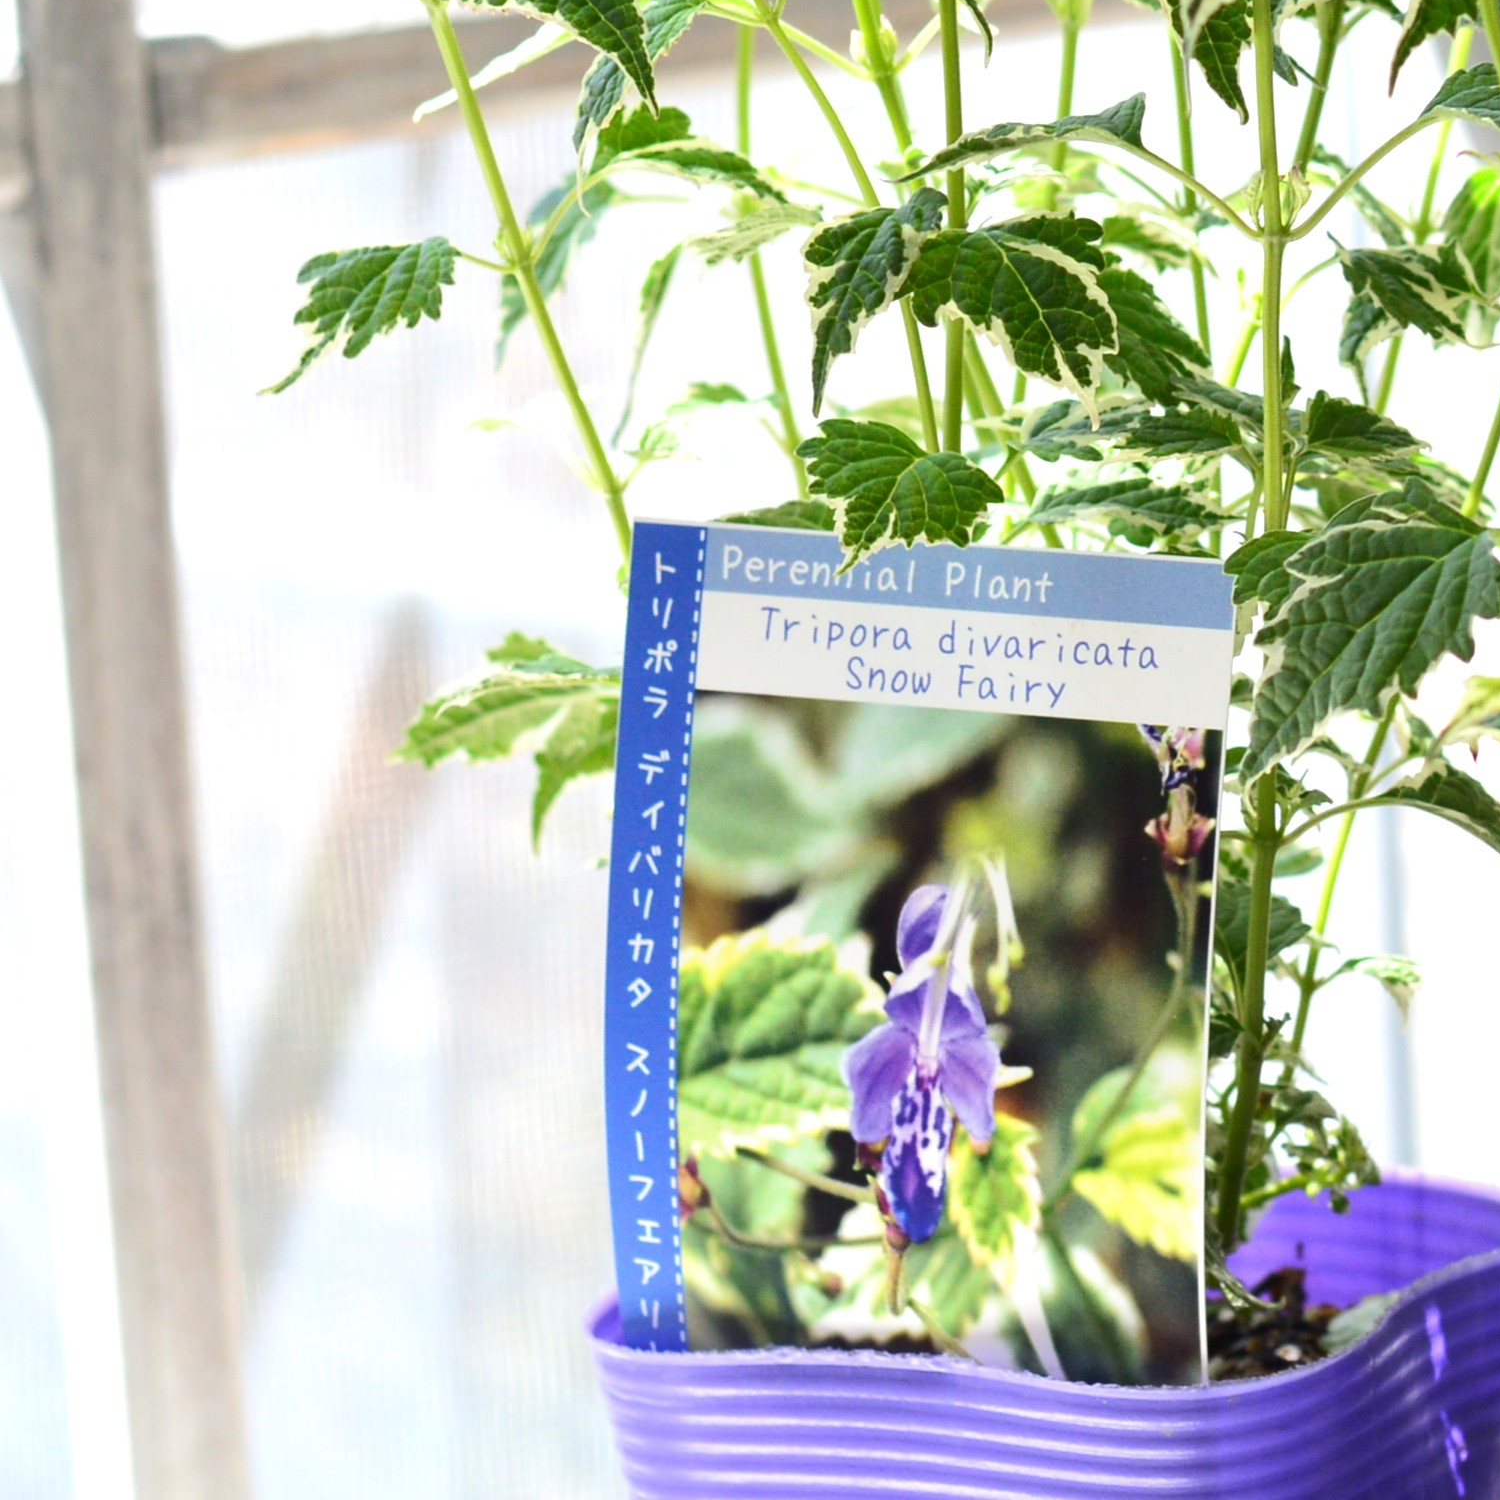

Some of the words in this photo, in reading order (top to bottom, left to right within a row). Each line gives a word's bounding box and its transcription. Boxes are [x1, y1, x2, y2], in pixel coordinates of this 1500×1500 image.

[722, 544, 916, 594] Perennial
[945, 560, 1055, 603] Plant
[643, 551, 679, 719] トリポラ
[760, 606, 913, 652] Tripora
[938, 619, 1160, 670] divaricata
[845, 657, 932, 693] Snow
[957, 663, 1067, 709] Fairy
